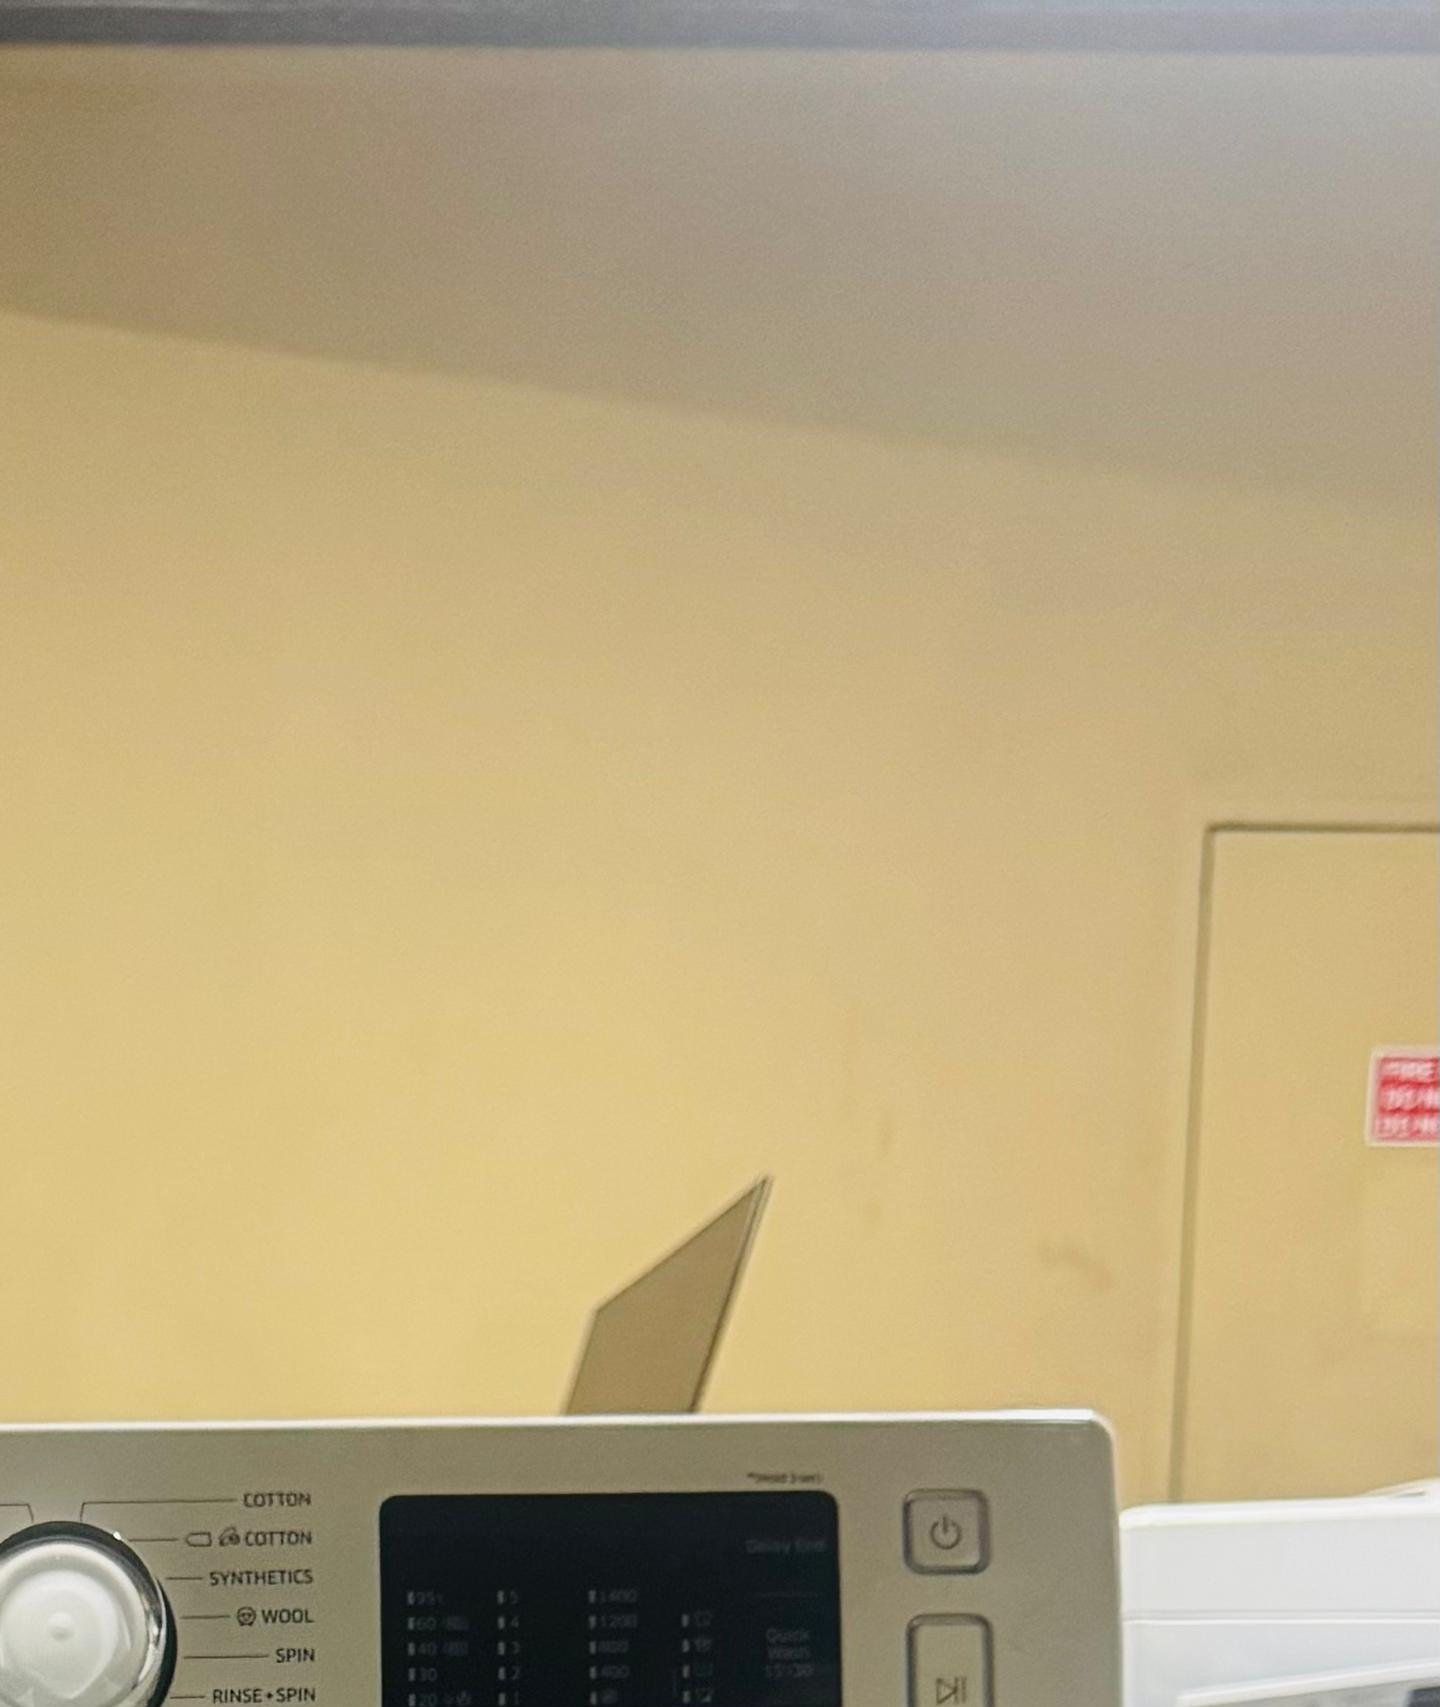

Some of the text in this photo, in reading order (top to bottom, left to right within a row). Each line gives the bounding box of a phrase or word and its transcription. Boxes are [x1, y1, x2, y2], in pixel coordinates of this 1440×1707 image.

[243, 1491, 312, 1509] COTTON
[244, 1530, 313, 1547] COTTON
[209, 1568, 314, 1587] SYNTHETICS
[261, 1608, 315, 1624] WOOL
[275, 1647, 316, 1664] SPIN
